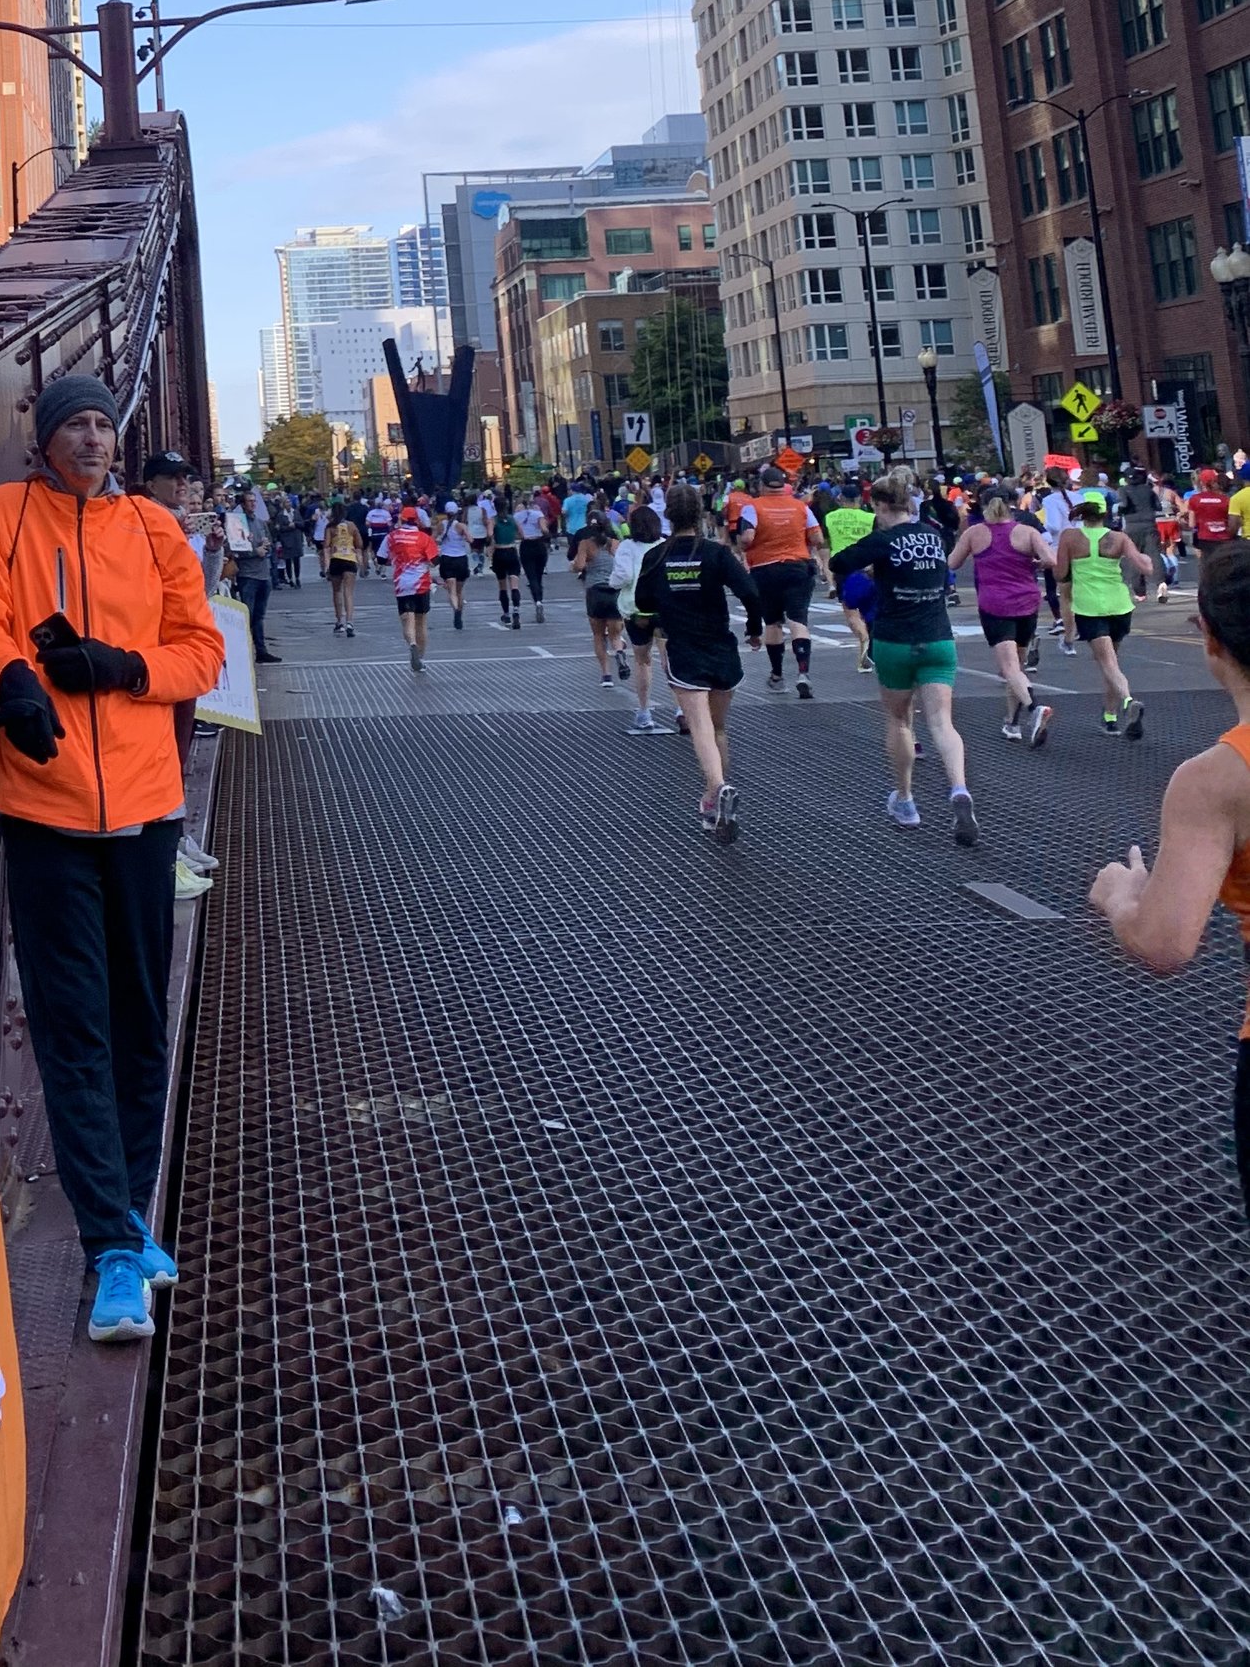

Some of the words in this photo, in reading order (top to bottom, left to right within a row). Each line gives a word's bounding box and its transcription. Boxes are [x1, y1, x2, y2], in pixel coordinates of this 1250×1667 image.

[1175, 409, 1194, 474] Whirlpool
[913, 559, 936, 570] 2014
[666, 571, 702, 581] TODAY
